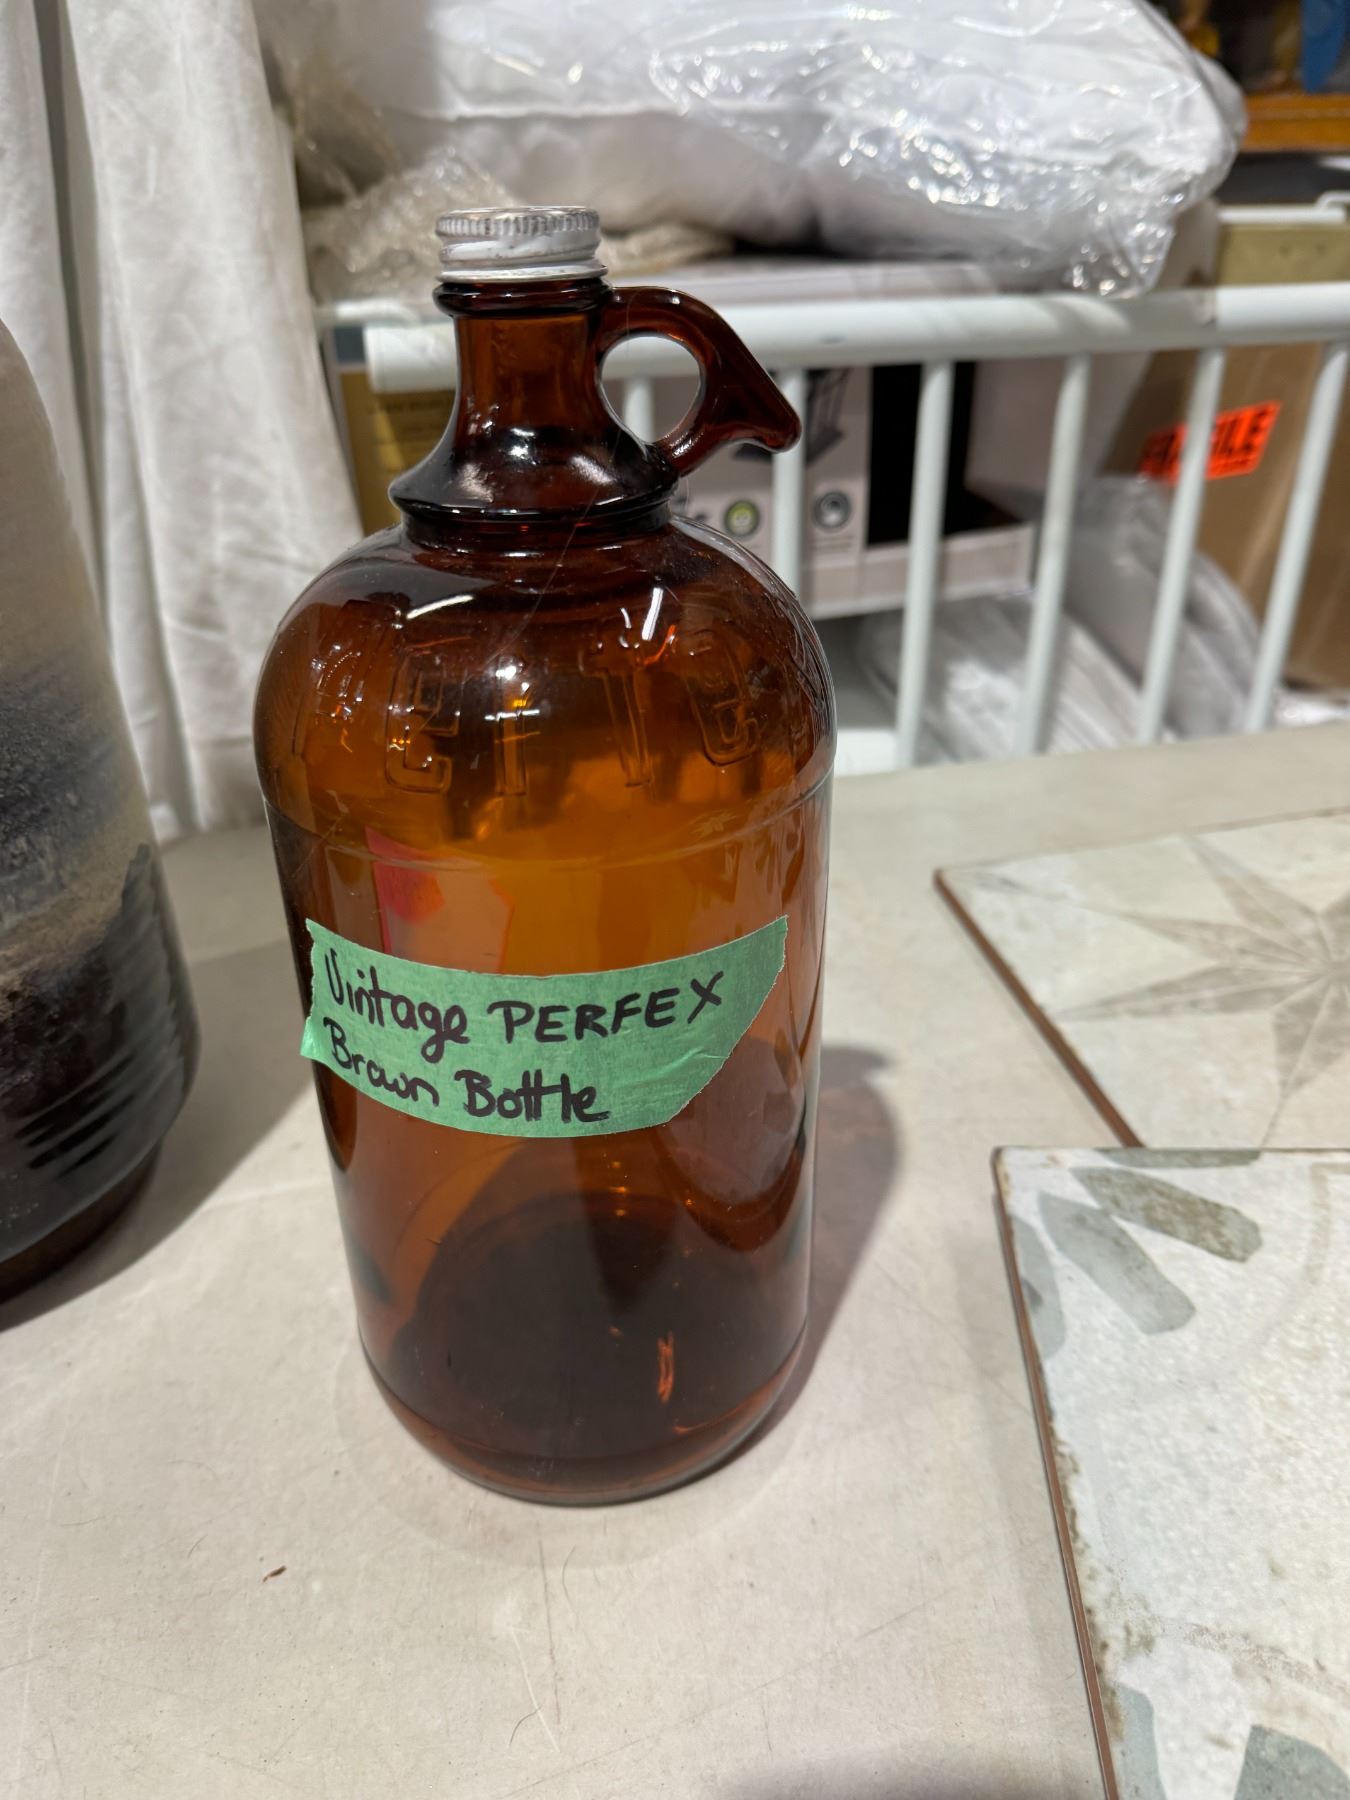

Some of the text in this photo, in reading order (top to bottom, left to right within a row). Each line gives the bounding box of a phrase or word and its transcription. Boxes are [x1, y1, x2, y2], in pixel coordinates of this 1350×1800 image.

[325, 948, 725, 1063] Vintage PERFEX
[323, 1016, 610, 1124] Brown Bottle
